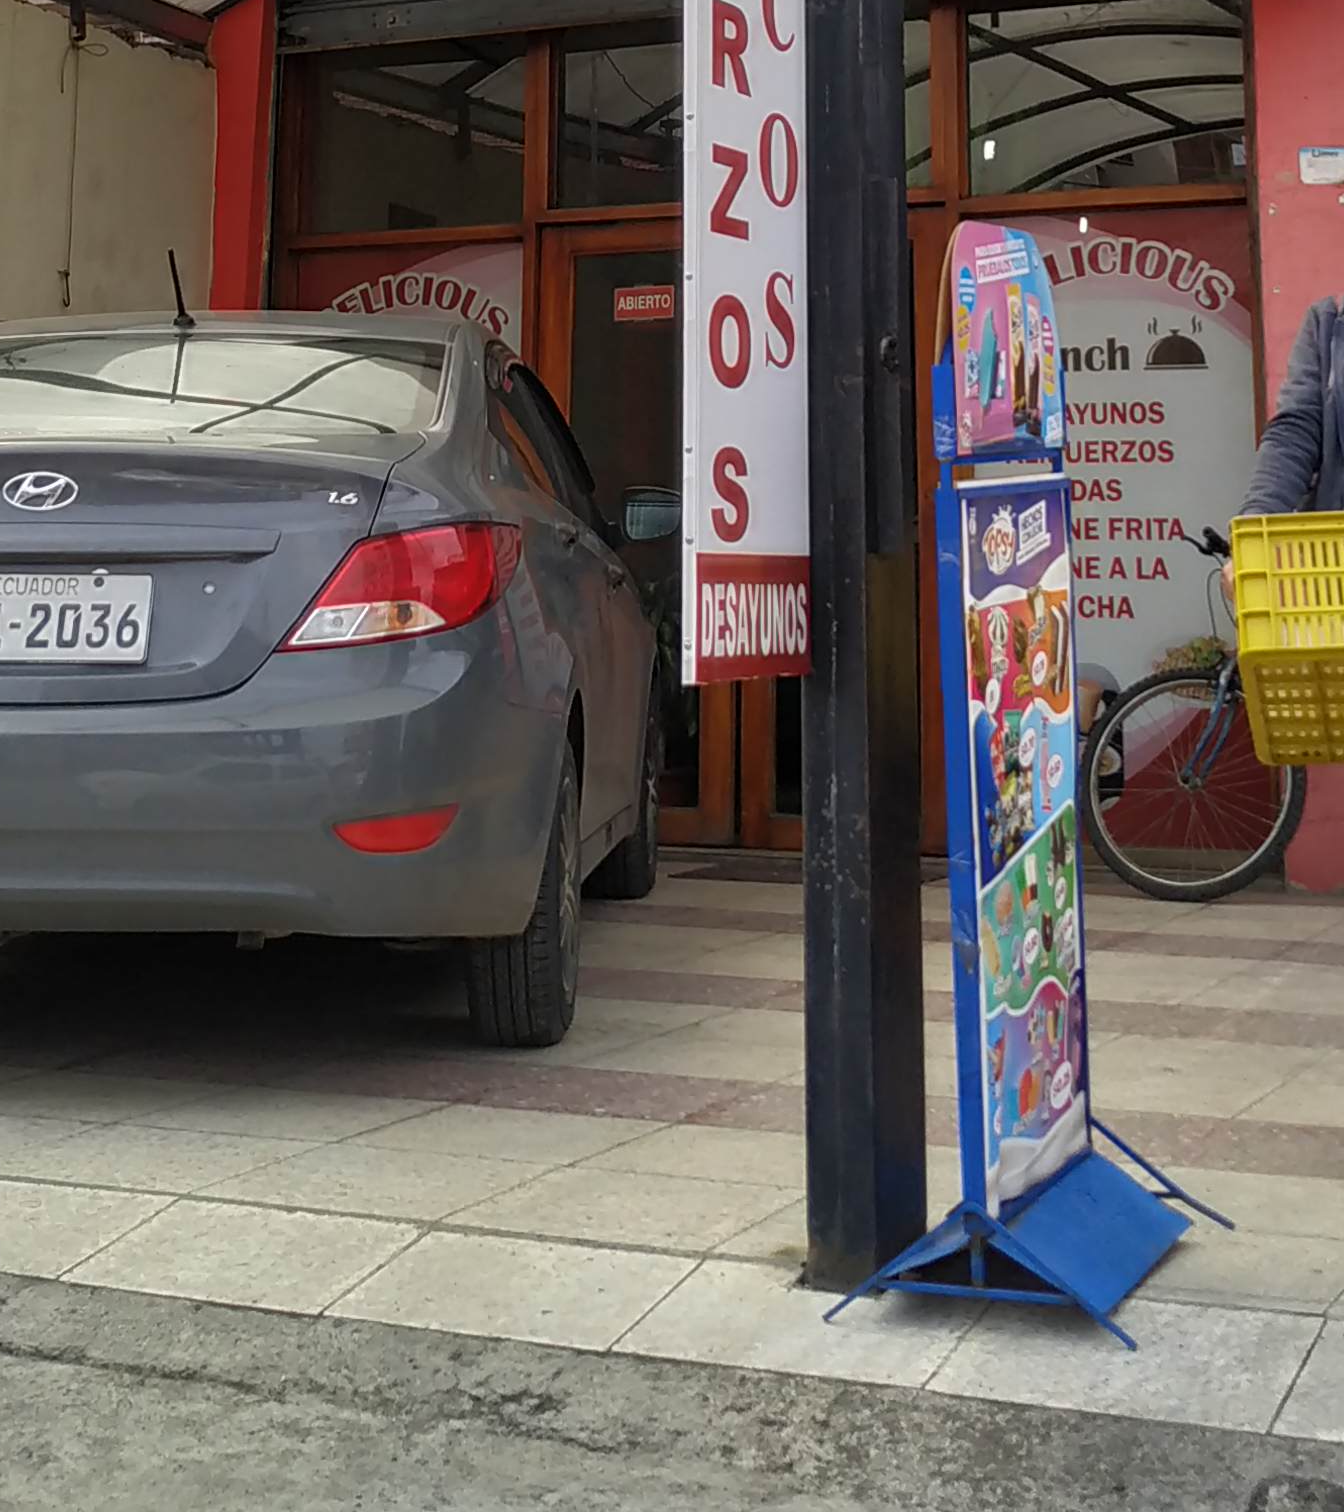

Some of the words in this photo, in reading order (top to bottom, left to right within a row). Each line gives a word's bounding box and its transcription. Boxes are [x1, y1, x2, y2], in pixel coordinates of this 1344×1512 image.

[1043, 241, 1229, 311] LICIOUS
[332, 274, 510, 337] ELICIOUS
[617, 293, 671, 312] ABIERTO
[1061, 337, 1131, 372] nch
[1065, 401, 1166, 425] AYUNOS
[1065, 440, 1175, 464] UERZOS
[327, 491, 359, 505] 1.6
[1070, 478, 1123, 502] DAS
[1071, 518, 1099, 540] NE
[1108, 517, 1185, 541] FRITA
[1071, 557, 1100, 579] NE
[1108, 557, 1127, 579] A
[1136, 556, 1169, 580] LA
[1078, 595, 1135, 619] CHA
[701, 582, 807, 657] DESAYUNOS
